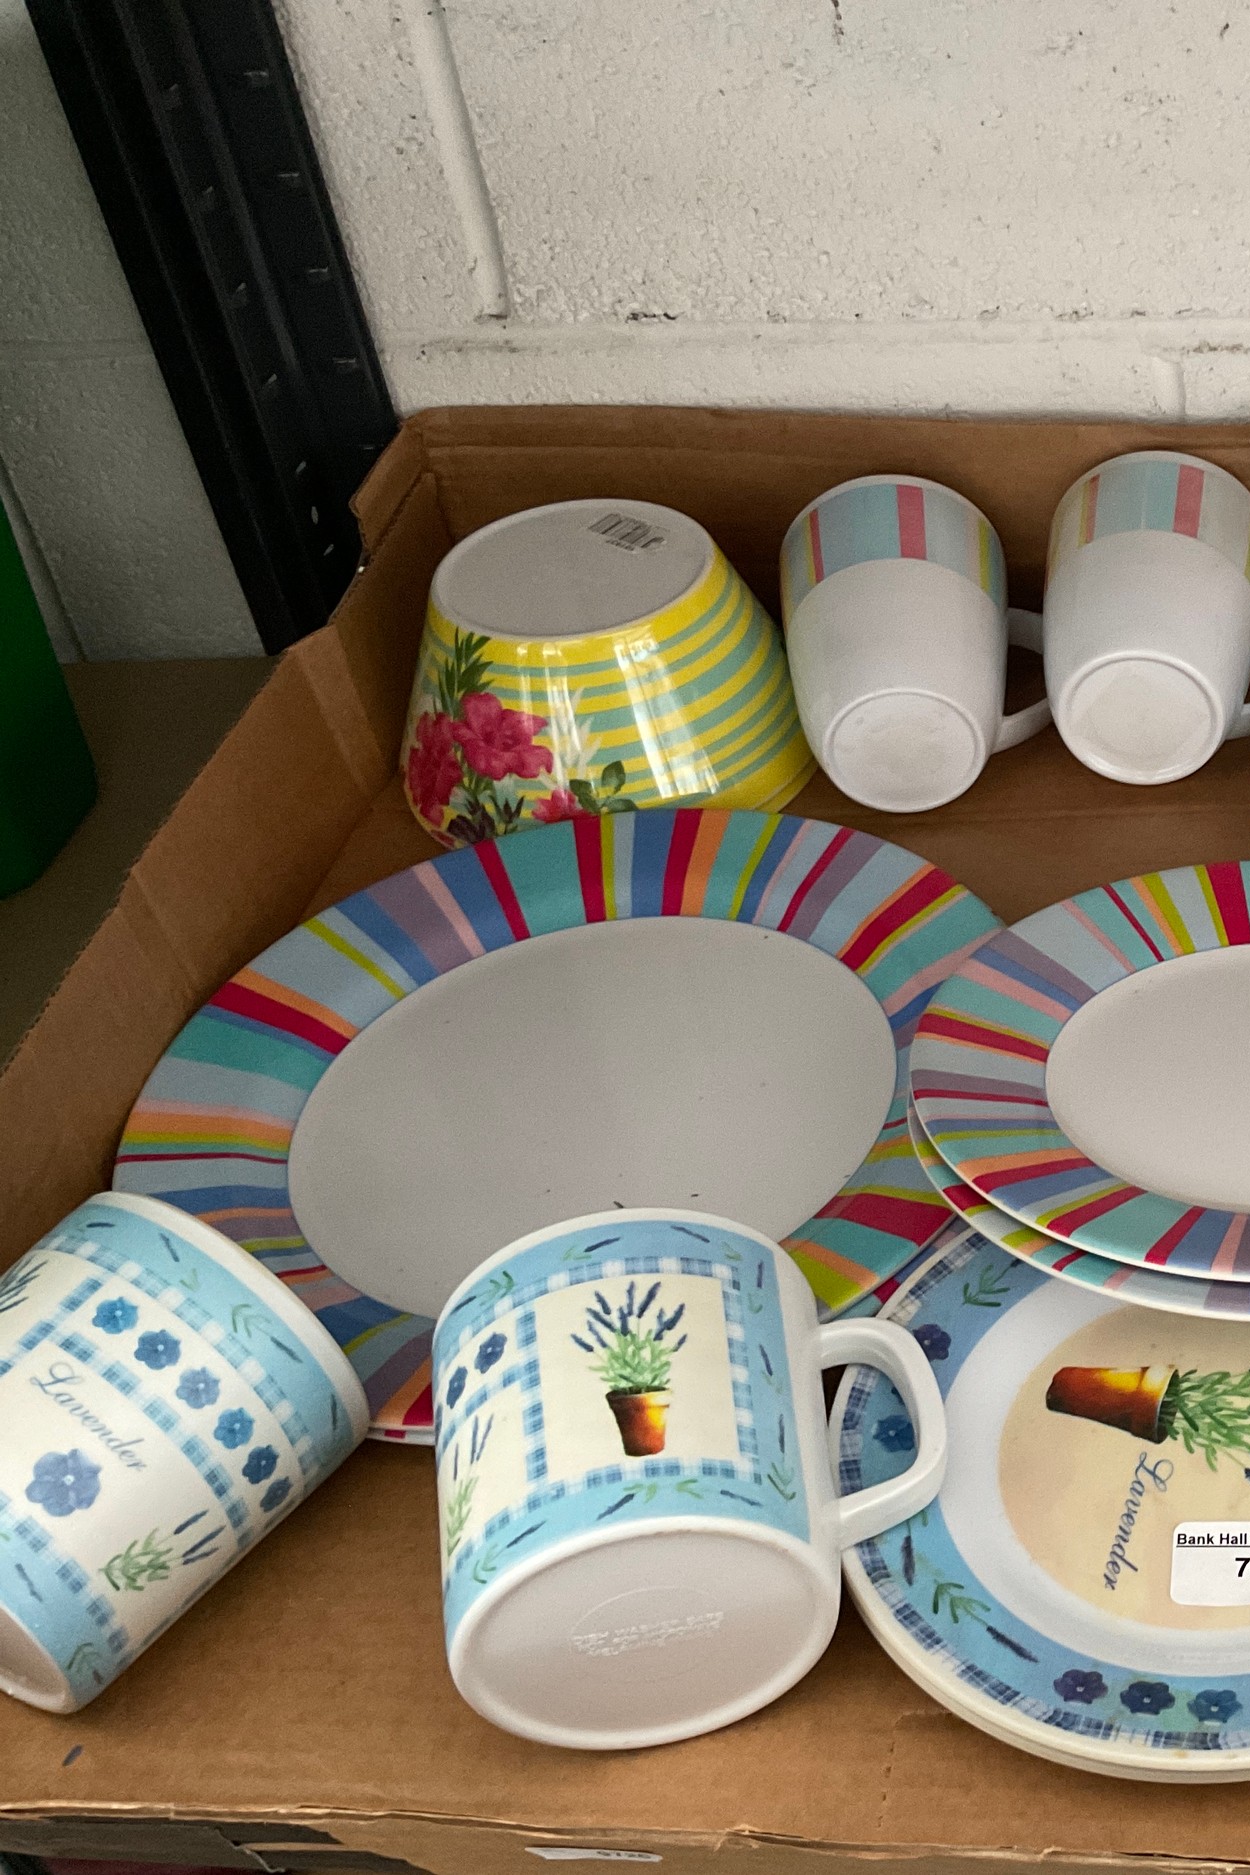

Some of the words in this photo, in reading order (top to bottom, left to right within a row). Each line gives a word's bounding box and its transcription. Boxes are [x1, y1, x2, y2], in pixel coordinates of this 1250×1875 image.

[29, 1361, 147, 1472] Lavender
[1103, 1451, 1175, 1592] Lavender
[1176, 1532, 1215, 1546] Bank
[1219, 1532, 1248, 1546] Hall
